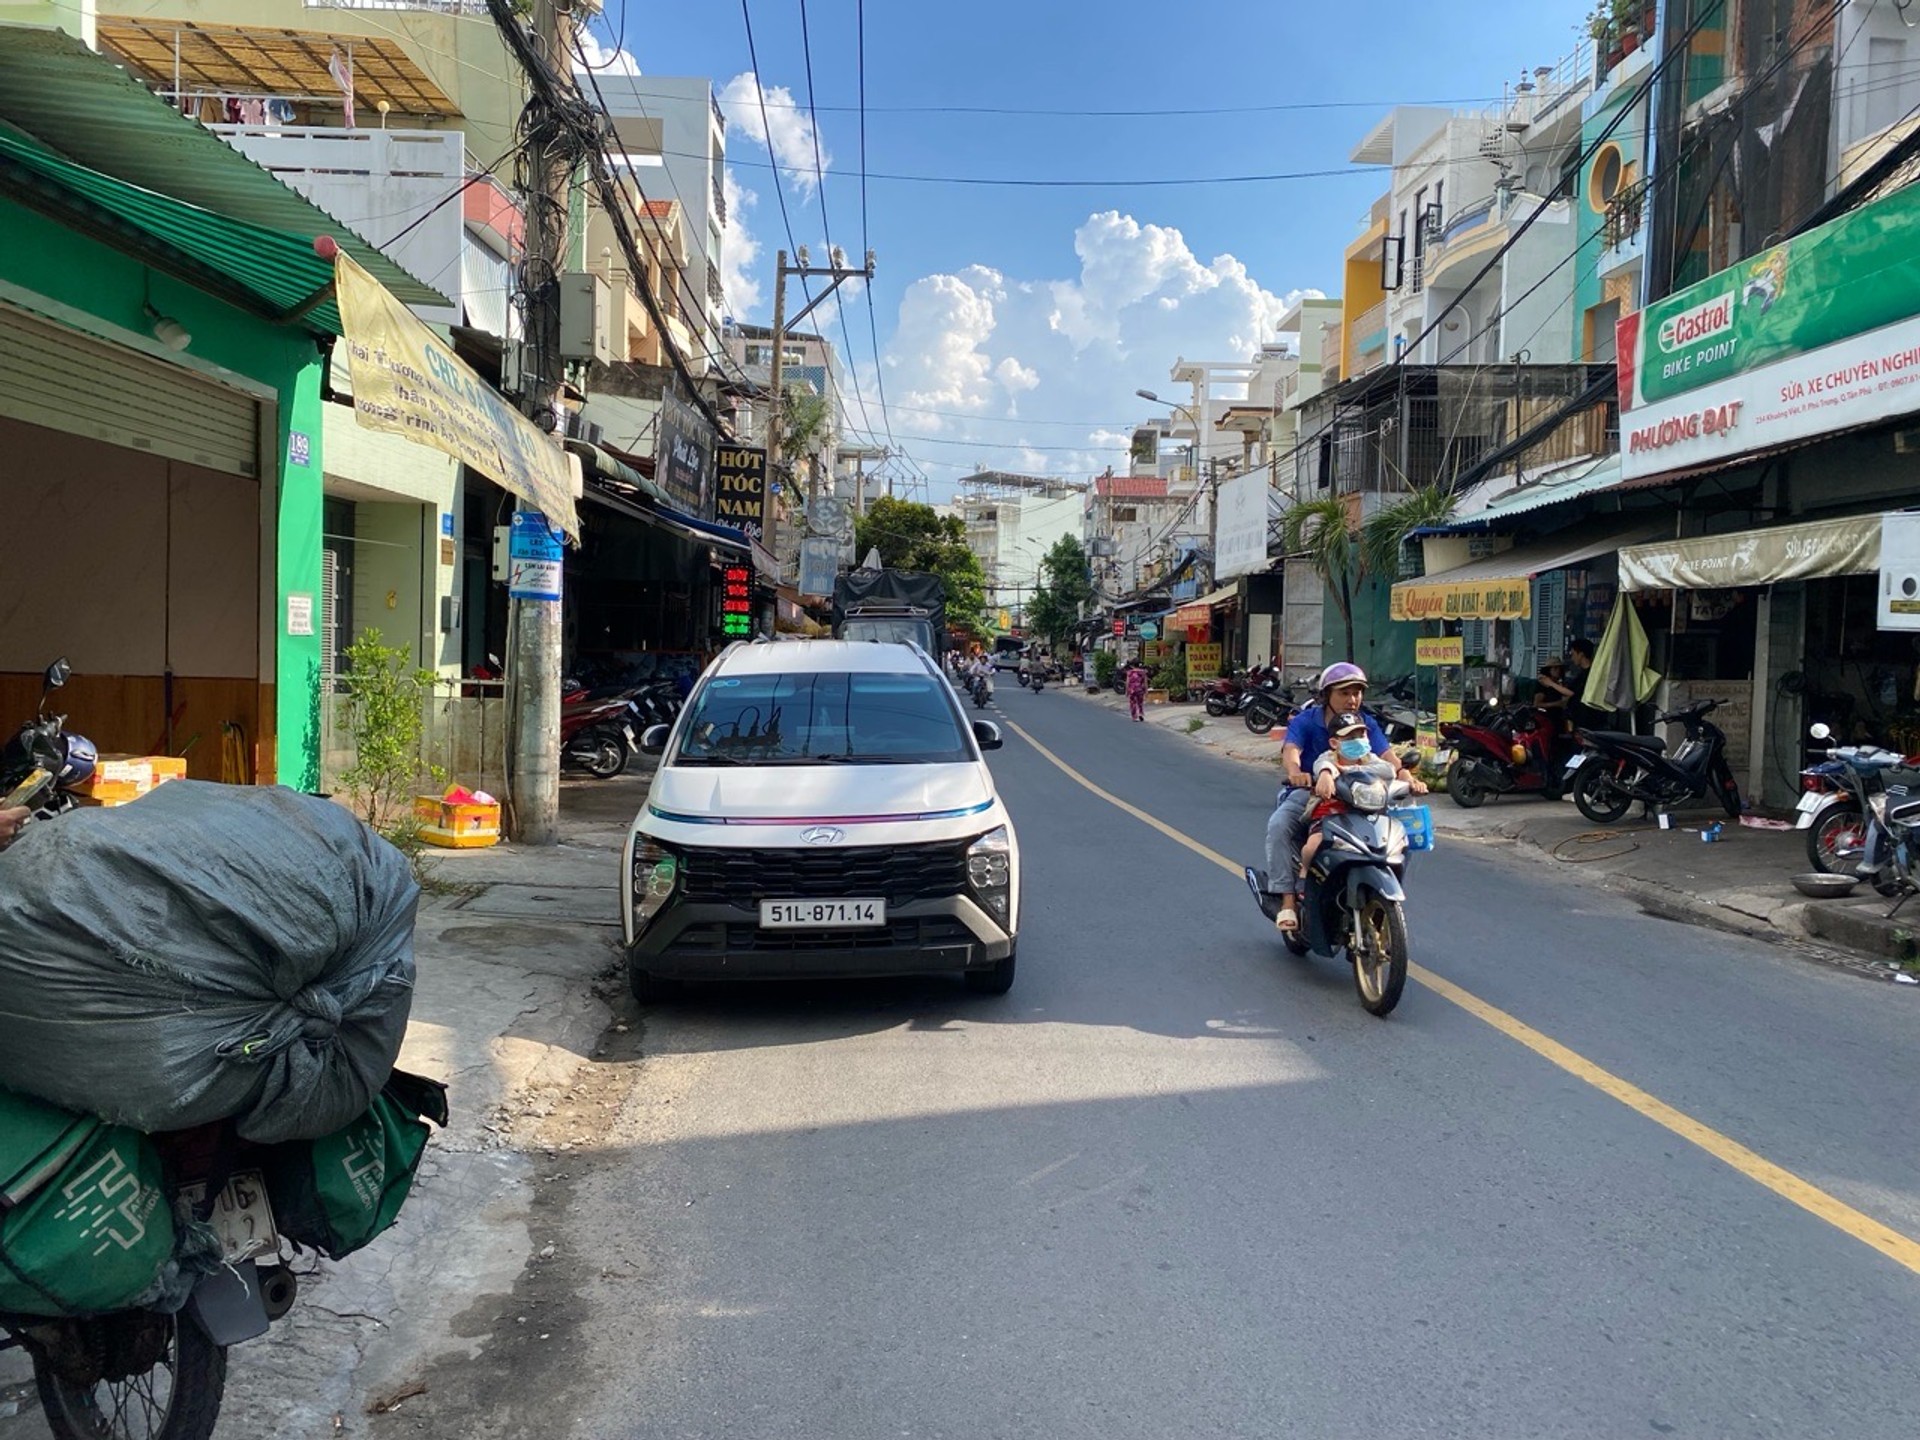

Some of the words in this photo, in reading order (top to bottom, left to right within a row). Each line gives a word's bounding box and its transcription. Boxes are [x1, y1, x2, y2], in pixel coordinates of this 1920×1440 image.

[1676, 298, 1729, 345] Castrol
[1662, 356, 1692, 379] BIKE
[1696, 338, 1738, 367] POINT
[1781, 379, 1805, 402] SỬA
[1808, 376, 1823, 395] XE
[1826, 360, 1879, 389] CHUYÊN
[1882, 345, 1920, 374] NGHI
[1629, 413, 1699, 455] PHƯƠNG
[1703, 400, 1744, 437] ĐẠT
[720, 450, 763, 469] HỚT
[720, 473, 762, 493] TÓC
[718, 499, 761, 517] NAM
[771, 904, 874, 922] 51L-871.14
